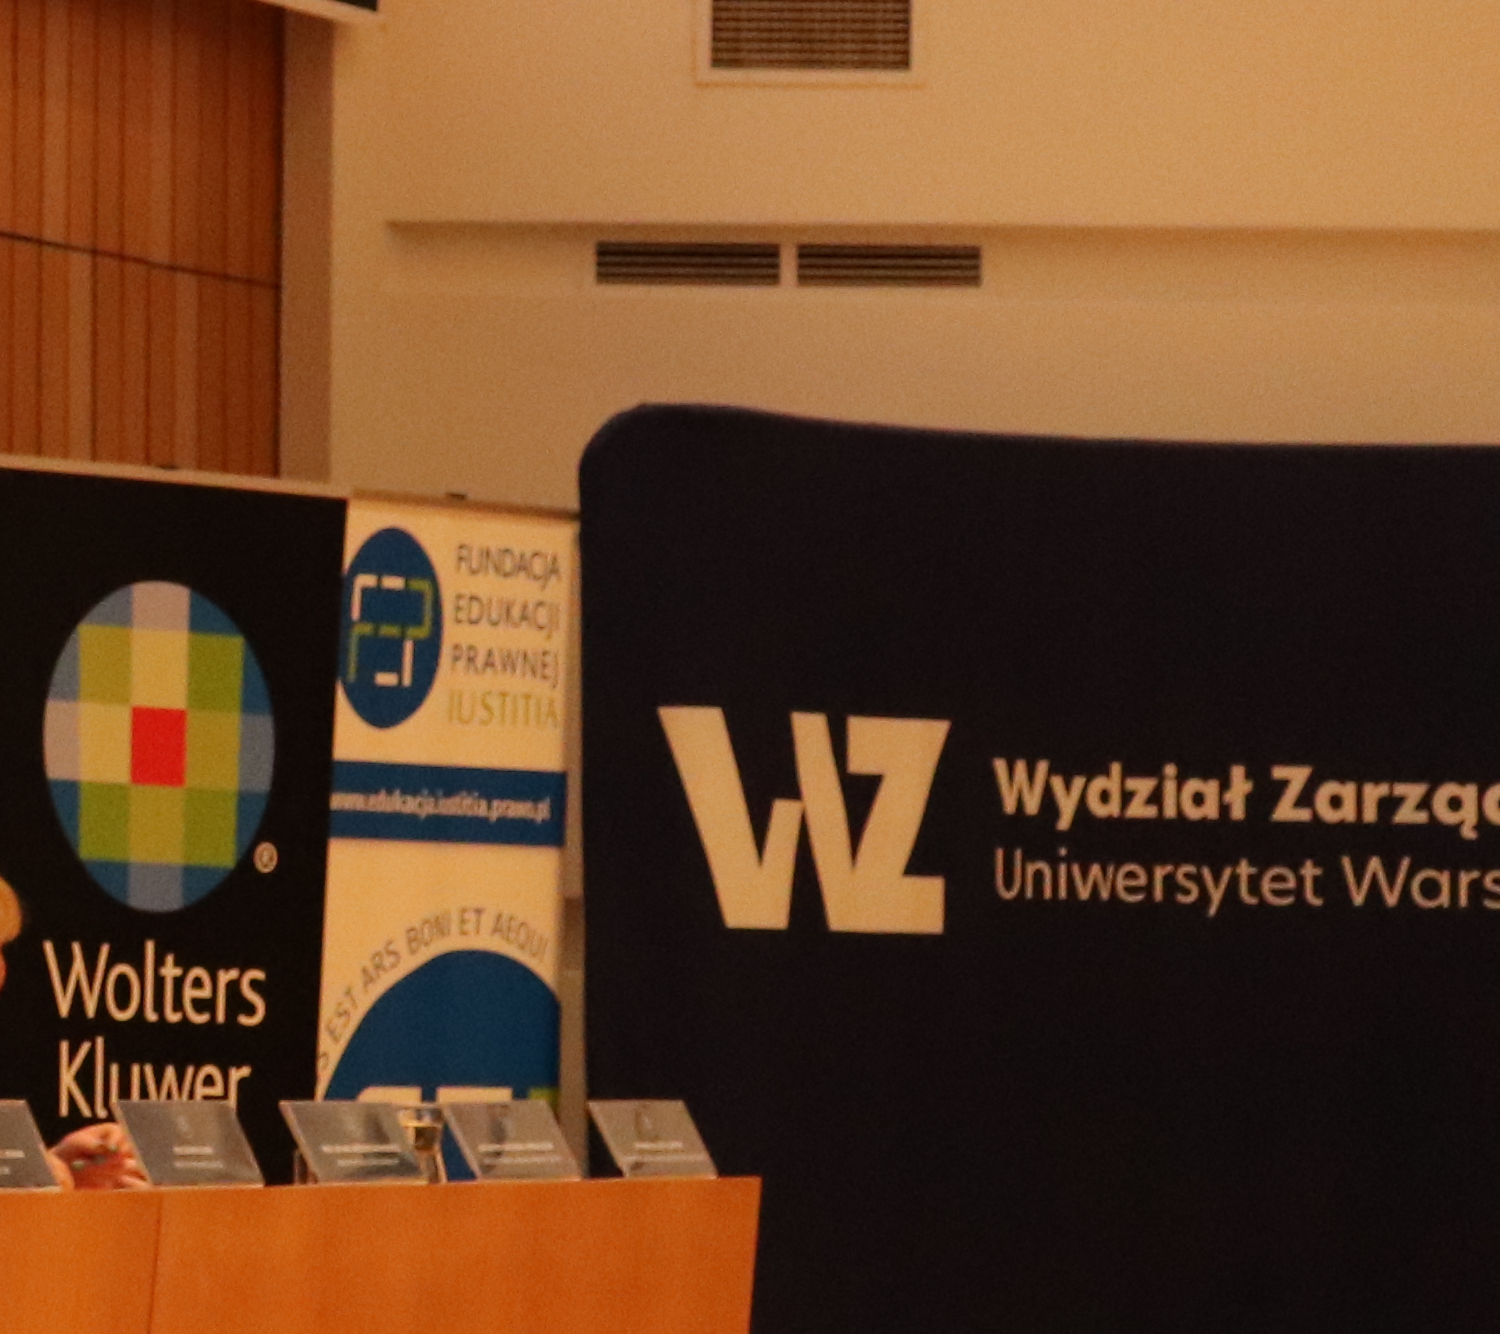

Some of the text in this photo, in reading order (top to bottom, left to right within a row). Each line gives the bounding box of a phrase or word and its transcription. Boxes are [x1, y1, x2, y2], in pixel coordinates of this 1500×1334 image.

[455, 543, 561, 591] FUNDACJA
[454, 593, 561, 642] EDUKACJI
[451, 643, 560, 690] PRAWNEJ
[448, 691, 560, 730] IUSTITIA
[657, 704, 952, 937] WZ
[992, 757, 1253, 831] Wydział
[994, 847, 1325, 918] Uniwersytet
[43, 939, 267, 1028] Wolters
[361, 939, 402, 994] ARS
[405, 910, 454, 957] BONI
[458, 907, 485, 936] ET
[491, 913, 550, 964] AEQUI
[58, 1035, 253, 1120] Kluwer
